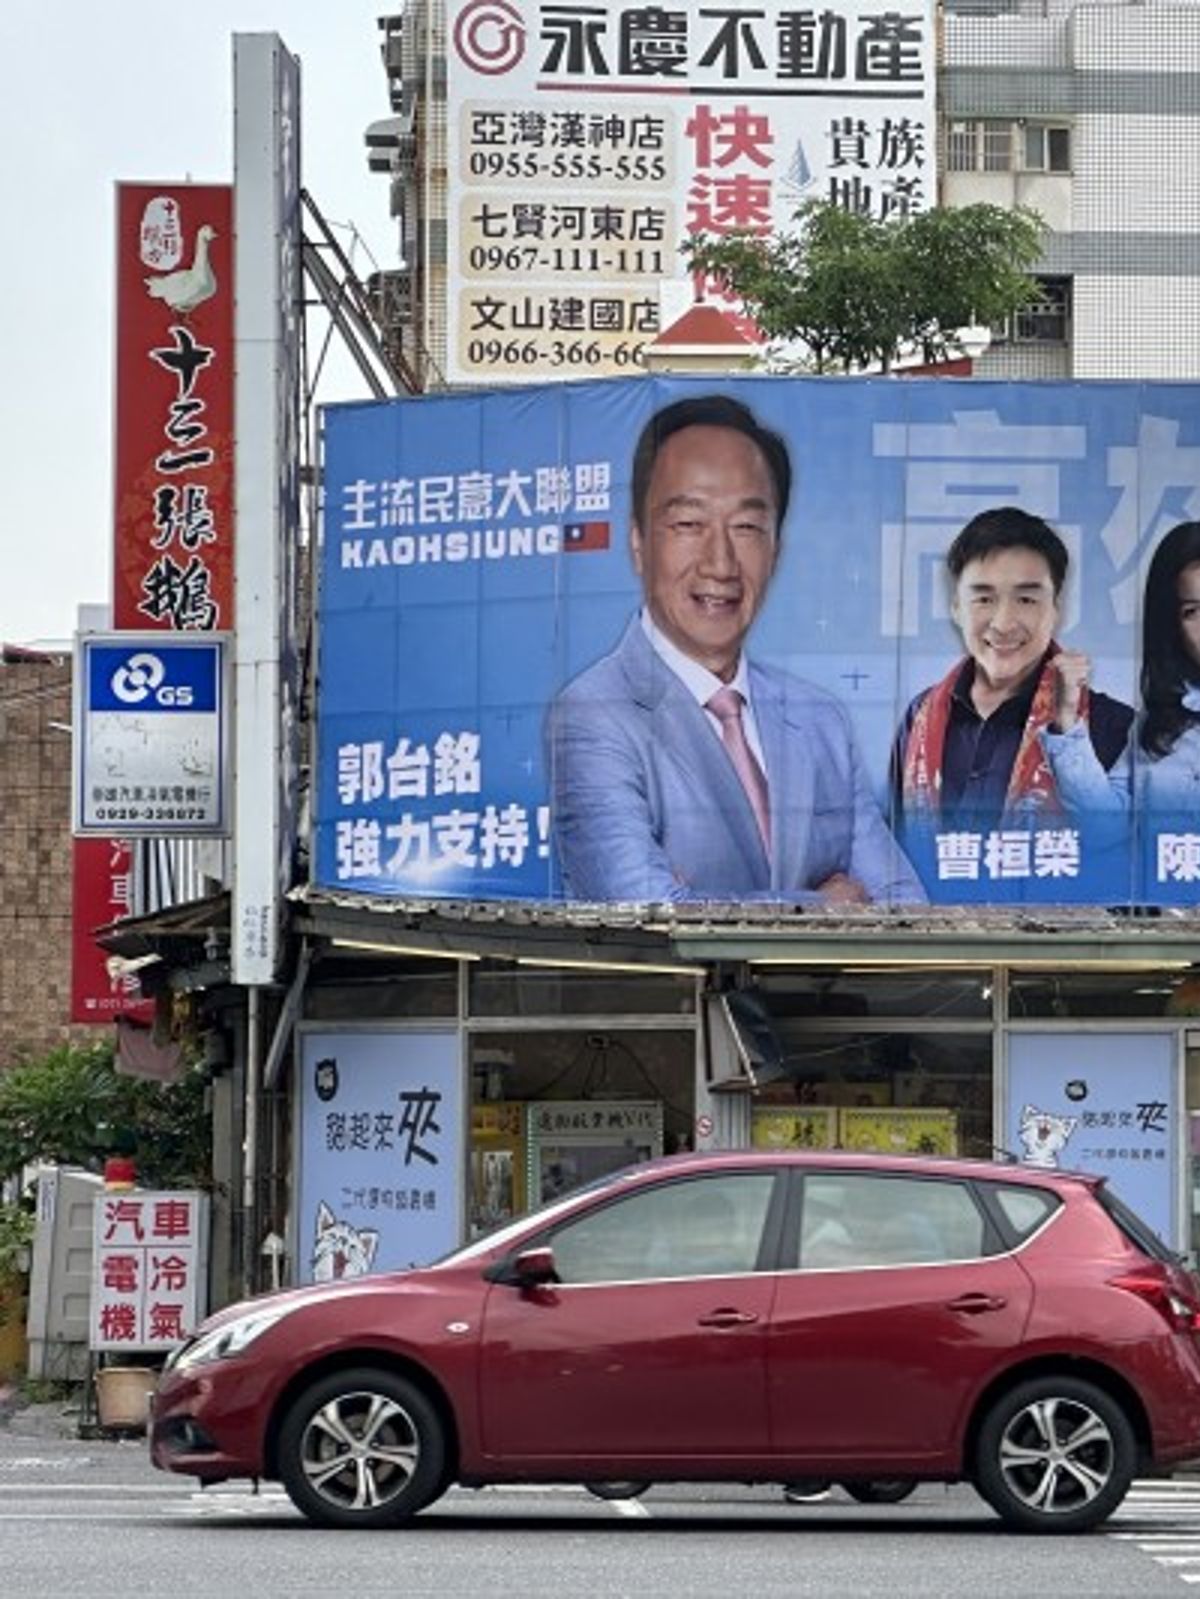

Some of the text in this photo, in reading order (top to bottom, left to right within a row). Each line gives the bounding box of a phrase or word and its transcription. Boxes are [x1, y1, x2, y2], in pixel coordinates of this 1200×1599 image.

[540, 5, 925, 82] 永慶不動產
[470, 110, 665, 149] 亞灣漢神店
[825, 116, 925, 169] 貴族
[470, 151, 665, 181] 0955-555-555
[472, 205, 665, 241] 七賢河東店
[469, 245, 664, 274] 0967-111-111
[470, 296, 660, 333] 文山建國店
[469, 339, 647, 366] 0966-366-66
[341, 461, 611, 530] 主流民意大聯盟
[341, 523, 562, 569] KAOHSIUNG
[155, 686, 194, 706] GS
[337, 731, 482, 805] 郭台銘
[936, 829, 1081, 881] 曹桓榮
[104, 1200, 191, 1240] 汽車
